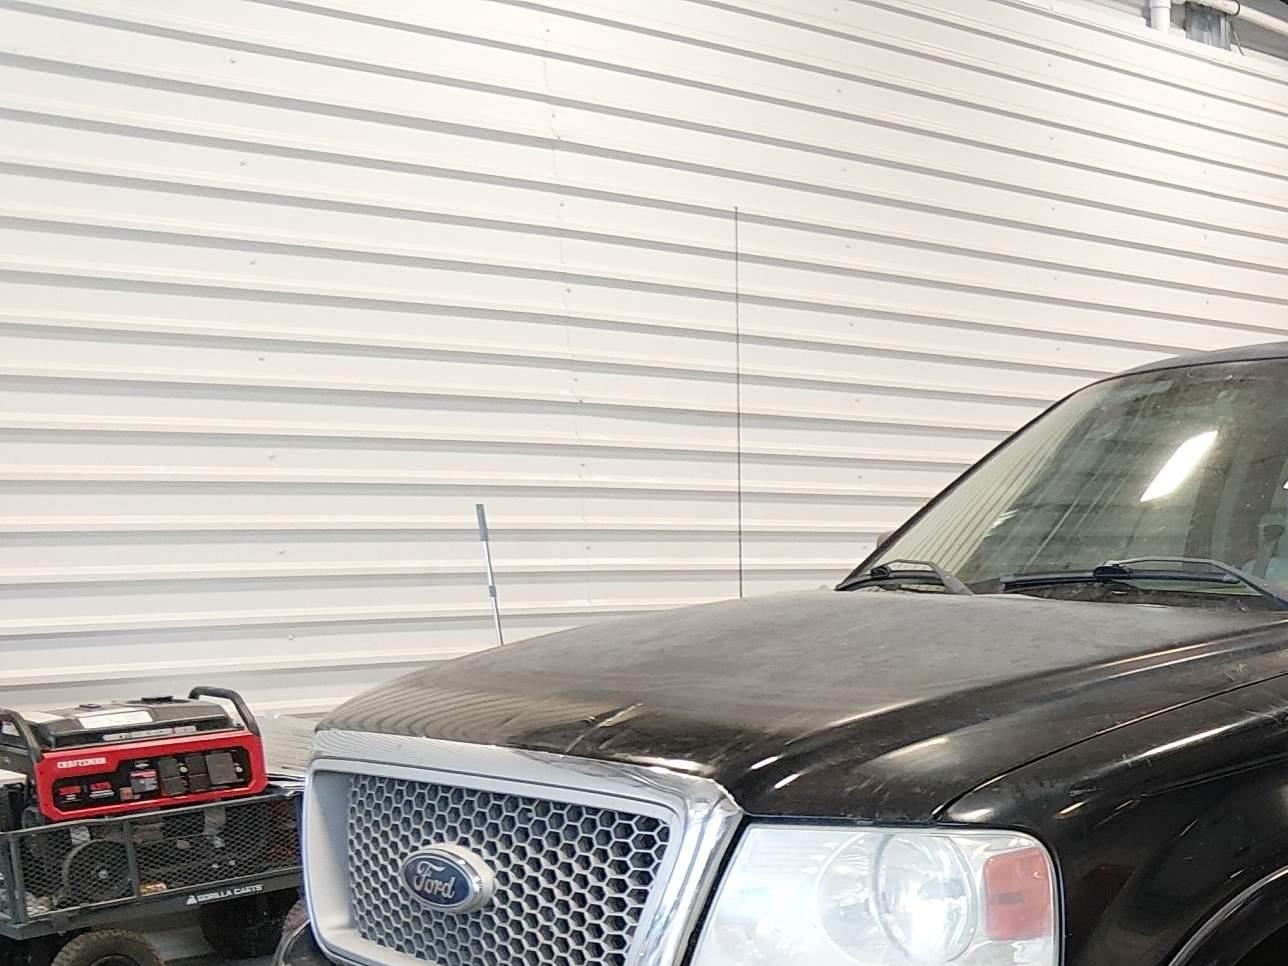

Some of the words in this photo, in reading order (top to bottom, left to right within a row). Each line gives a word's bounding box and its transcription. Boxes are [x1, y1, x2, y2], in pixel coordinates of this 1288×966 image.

[197, 890, 232, 902] GORILLA
[234, 885, 262, 895] CARTS
[413, 860, 456, 899] Ford
